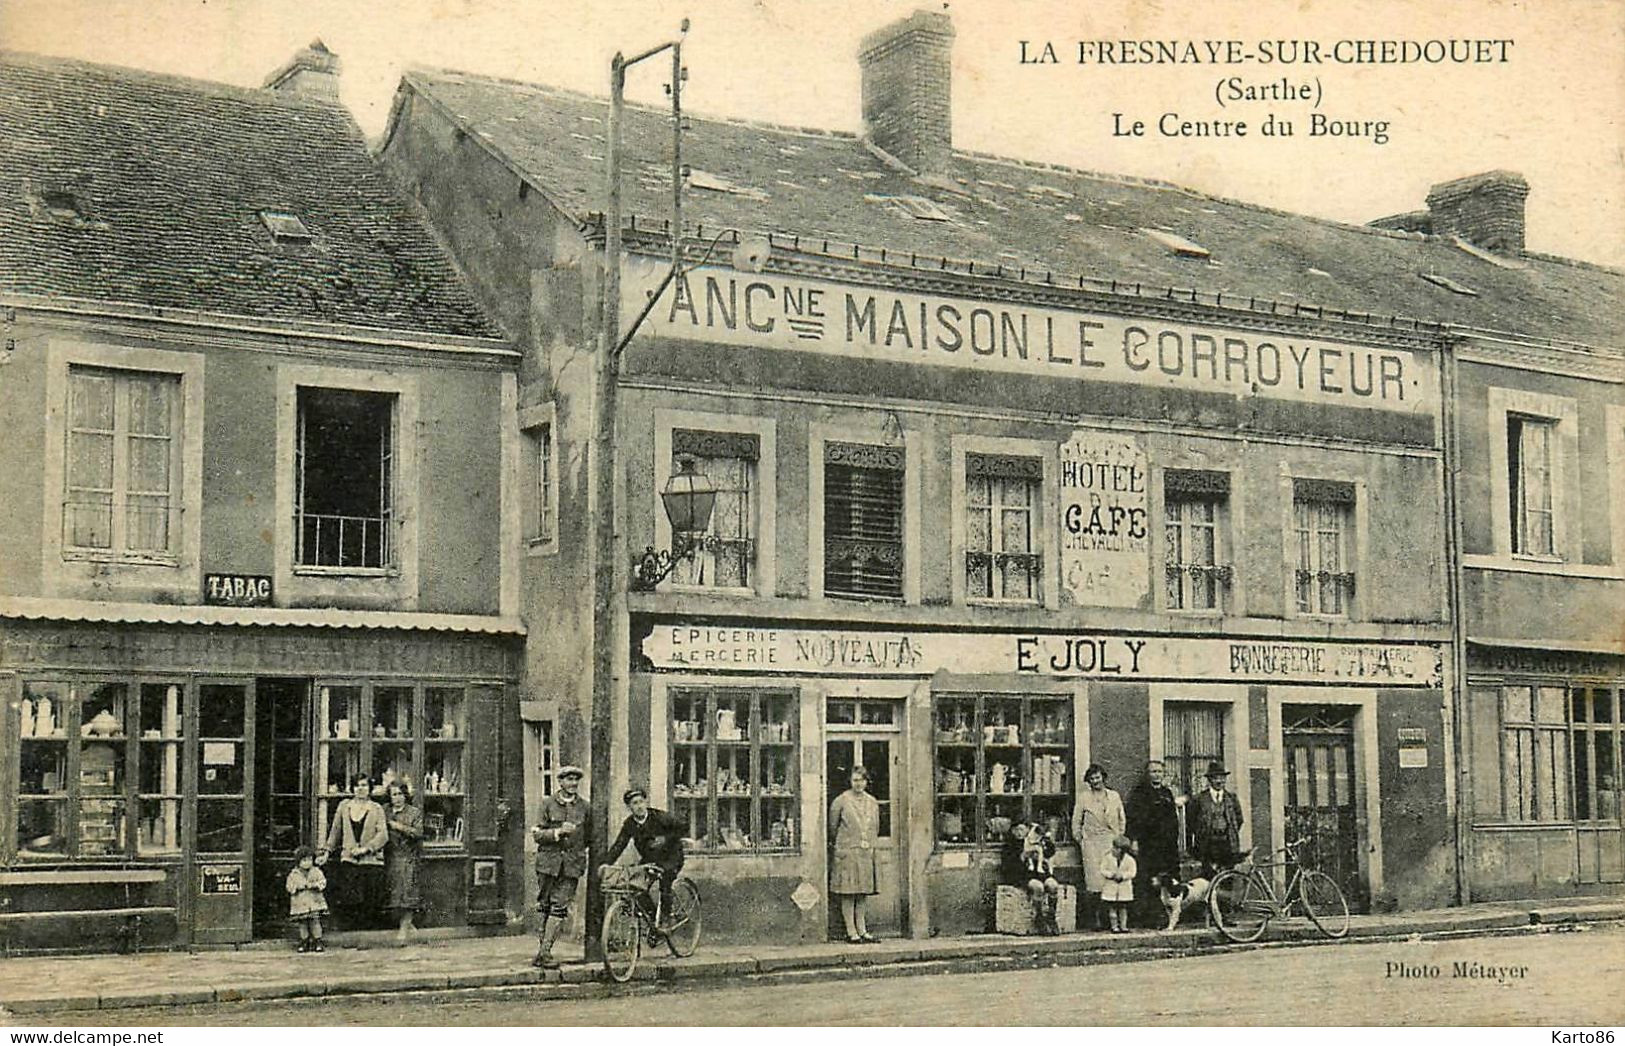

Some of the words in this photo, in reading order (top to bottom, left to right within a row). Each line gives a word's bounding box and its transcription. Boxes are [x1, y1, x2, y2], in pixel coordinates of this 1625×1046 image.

[845, 293, 1029, 361] MAISON
[1047, 316, 1105, 368] LE
[1122, 325, 1404, 400] CORROYEUR
[208, 576, 270, 599] TABAC
[672, 628, 777, 645] EPICERIE
[671, 648, 777, 664] MERCERIE
[1017, 637, 1039, 673] E
[1050, 639, 1146, 674] JOLY
